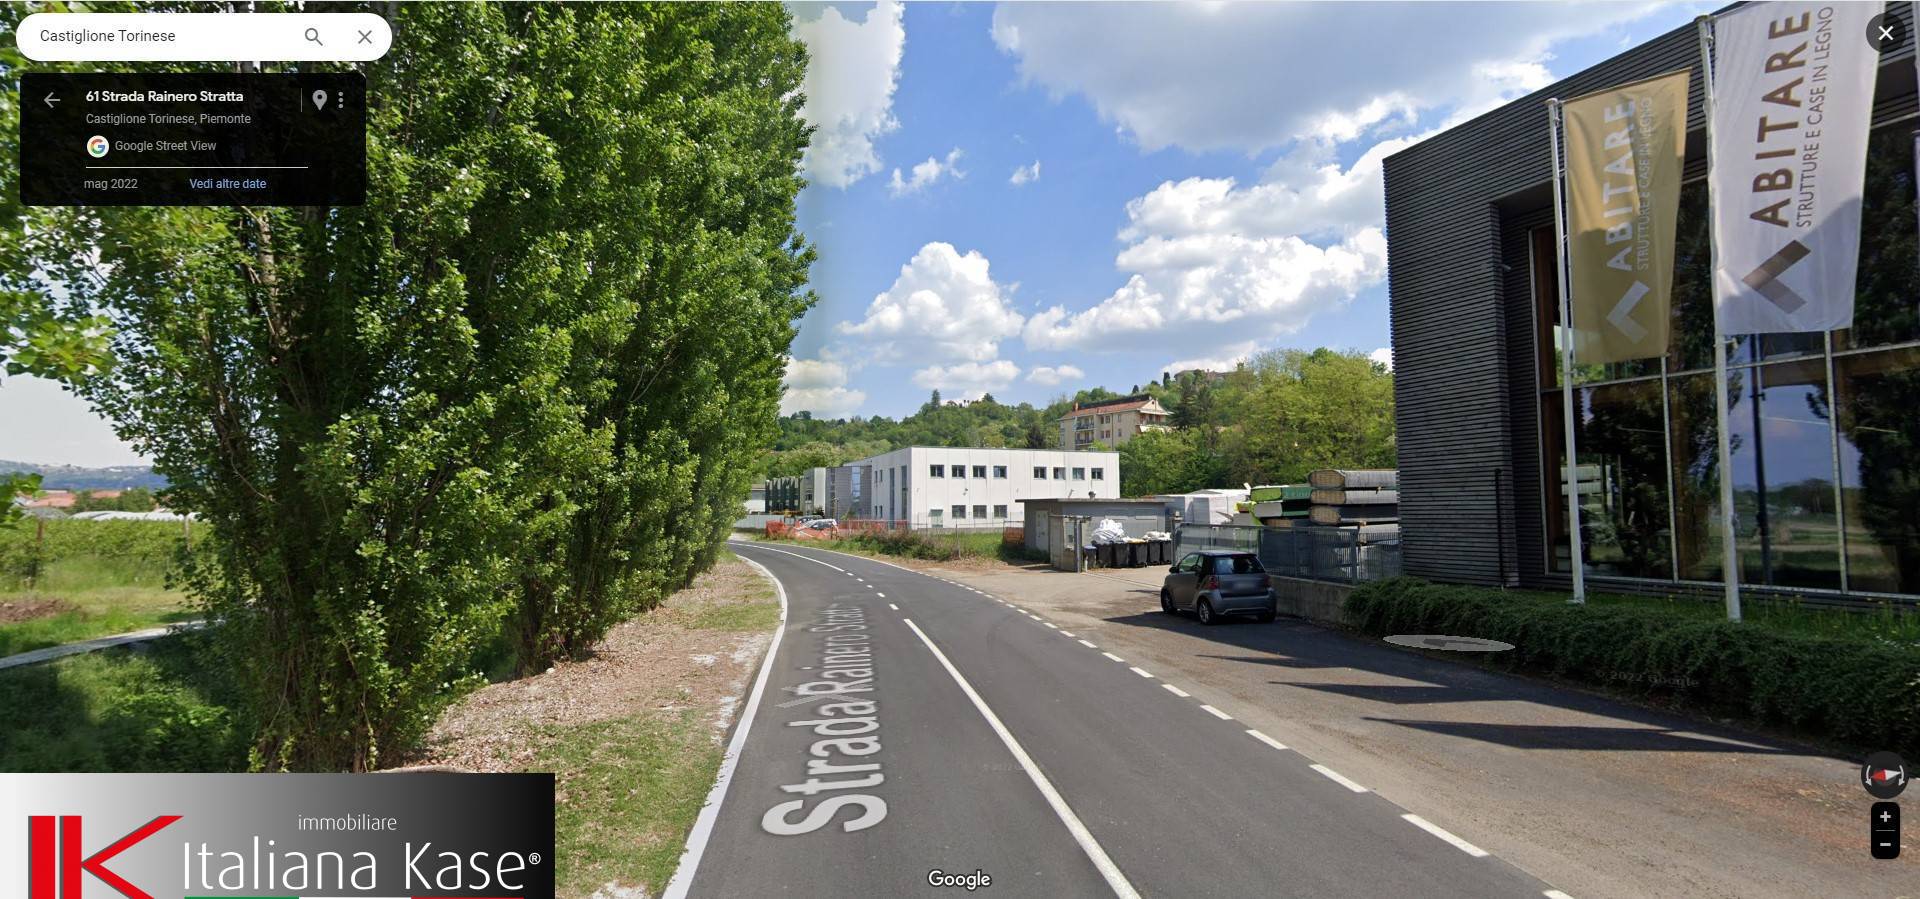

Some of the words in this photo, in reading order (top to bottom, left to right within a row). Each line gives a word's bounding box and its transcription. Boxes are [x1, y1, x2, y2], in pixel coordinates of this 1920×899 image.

[1814, 6, 1835, 60] LEGNO
[1811, 64, 1828, 82] IN
[1749, 12, 1811, 228] ABITARE
[1807, 86, 1827, 125] CASE
[1804, 130, 1821, 139] E
[1603, 101, 1636, 271] ABITARE
[1639, 158, 1651, 188] CASE
[1796, 143, 1820, 228] STRUTTURE
[1637, 201, 1650, 271] STRUTTURE
